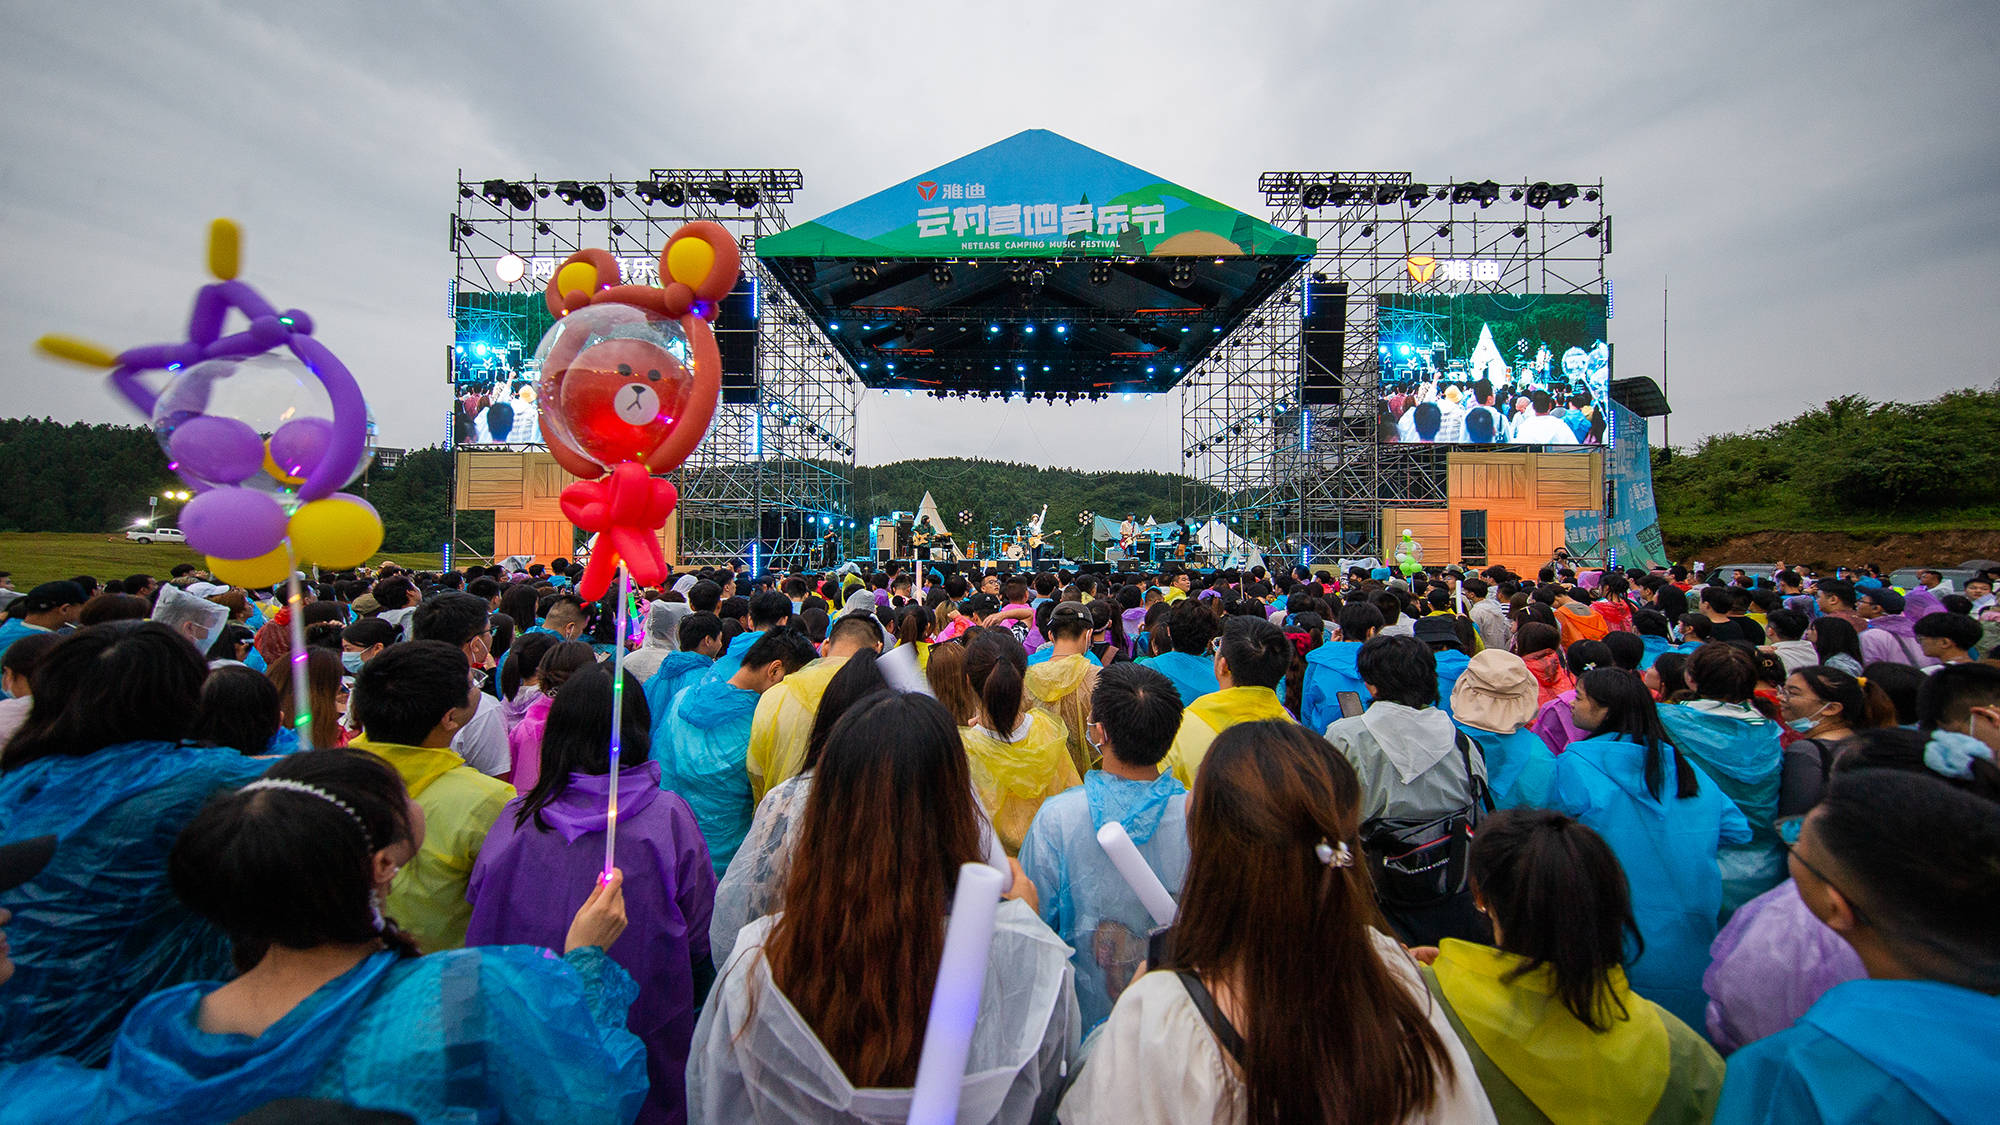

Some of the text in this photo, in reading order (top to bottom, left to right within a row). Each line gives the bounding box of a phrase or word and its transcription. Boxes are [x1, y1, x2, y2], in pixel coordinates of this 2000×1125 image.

[942, 183, 985, 199] 雅迪
[917, 203, 1165, 238] 云村营地音乐节
[961, 240, 1121, 250] NETEASE CAMPING MUSIC FESTIVAL
[1440, 259, 1499, 281] 雅迪
